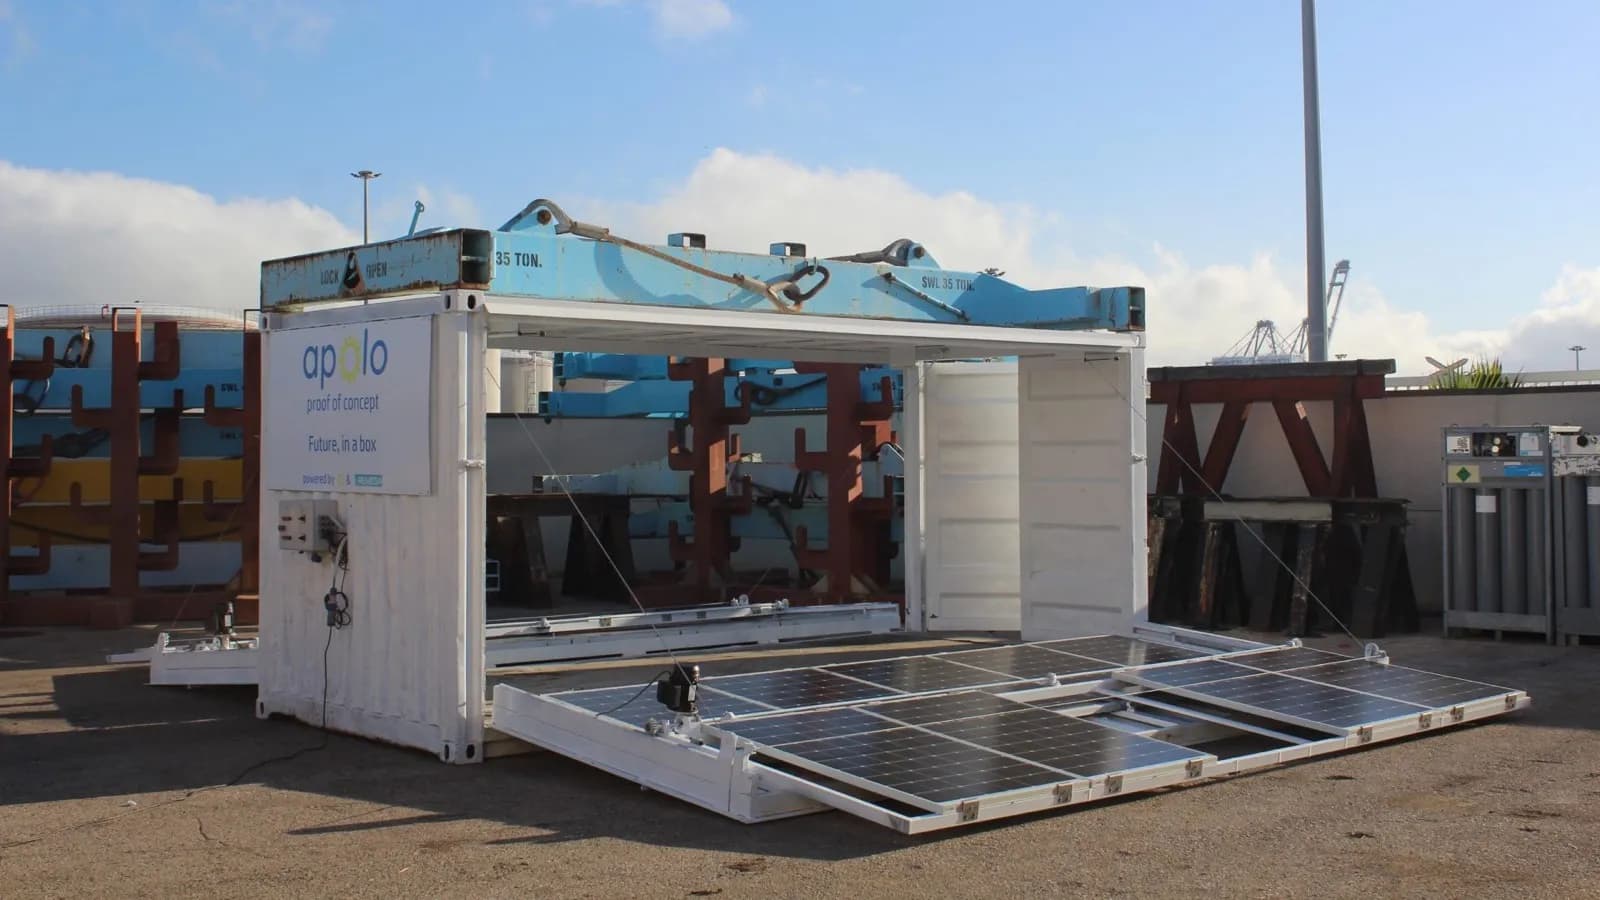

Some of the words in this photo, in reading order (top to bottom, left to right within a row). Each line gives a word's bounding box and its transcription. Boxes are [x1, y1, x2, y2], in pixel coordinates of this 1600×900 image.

[496, 251, 511, 266] 35
[514, 252, 543, 268] TON.
[320, 269, 340, 286] LOCK
[366, 261, 388, 280] OPEN
[921, 276, 940, 288] SWL
[942, 278, 953, 290] 35
[303, 328, 388, 390] apolo
[306, 393, 331, 415] proof
[332, 393, 342, 411] of
[343, 393, 379, 414] concept
[308, 435, 340, 454] Future,
[341, 434, 350, 452] in
[352, 439, 358, 452] a
[359, 434, 377, 452] box
